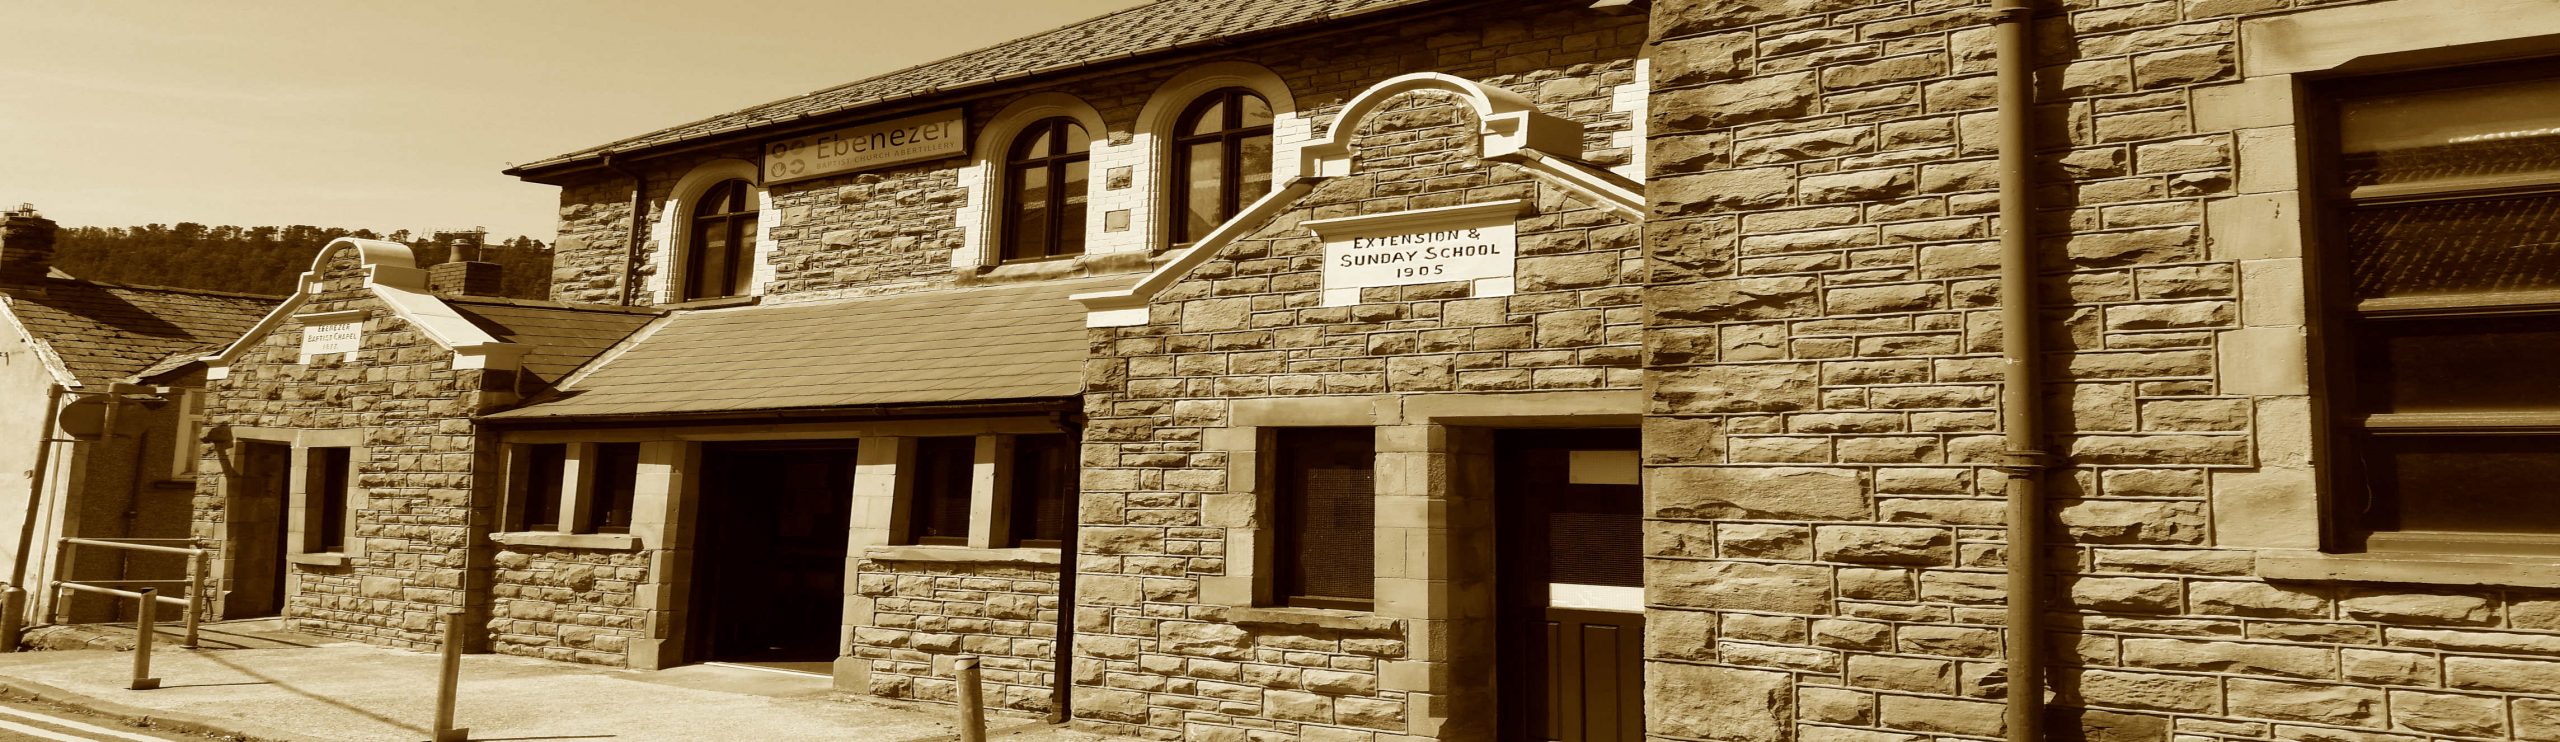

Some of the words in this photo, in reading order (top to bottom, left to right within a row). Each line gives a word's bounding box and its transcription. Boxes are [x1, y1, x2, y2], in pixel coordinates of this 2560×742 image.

[817, 120, 954, 159] Ebenezer
[816, 159, 850, 170] BAPTIST
[854, 152, 890, 163] CHURCH
[894, 142, 955, 157] ABERTILLERY
[1353, 230, 1459, 250] EXTENSION
[1467, 228, 1481, 240] &
[1340, 251, 1418, 268] SUNDAY
[1424, 243, 1501, 260] SCHOOL
[1396, 264, 1444, 279] 1905
